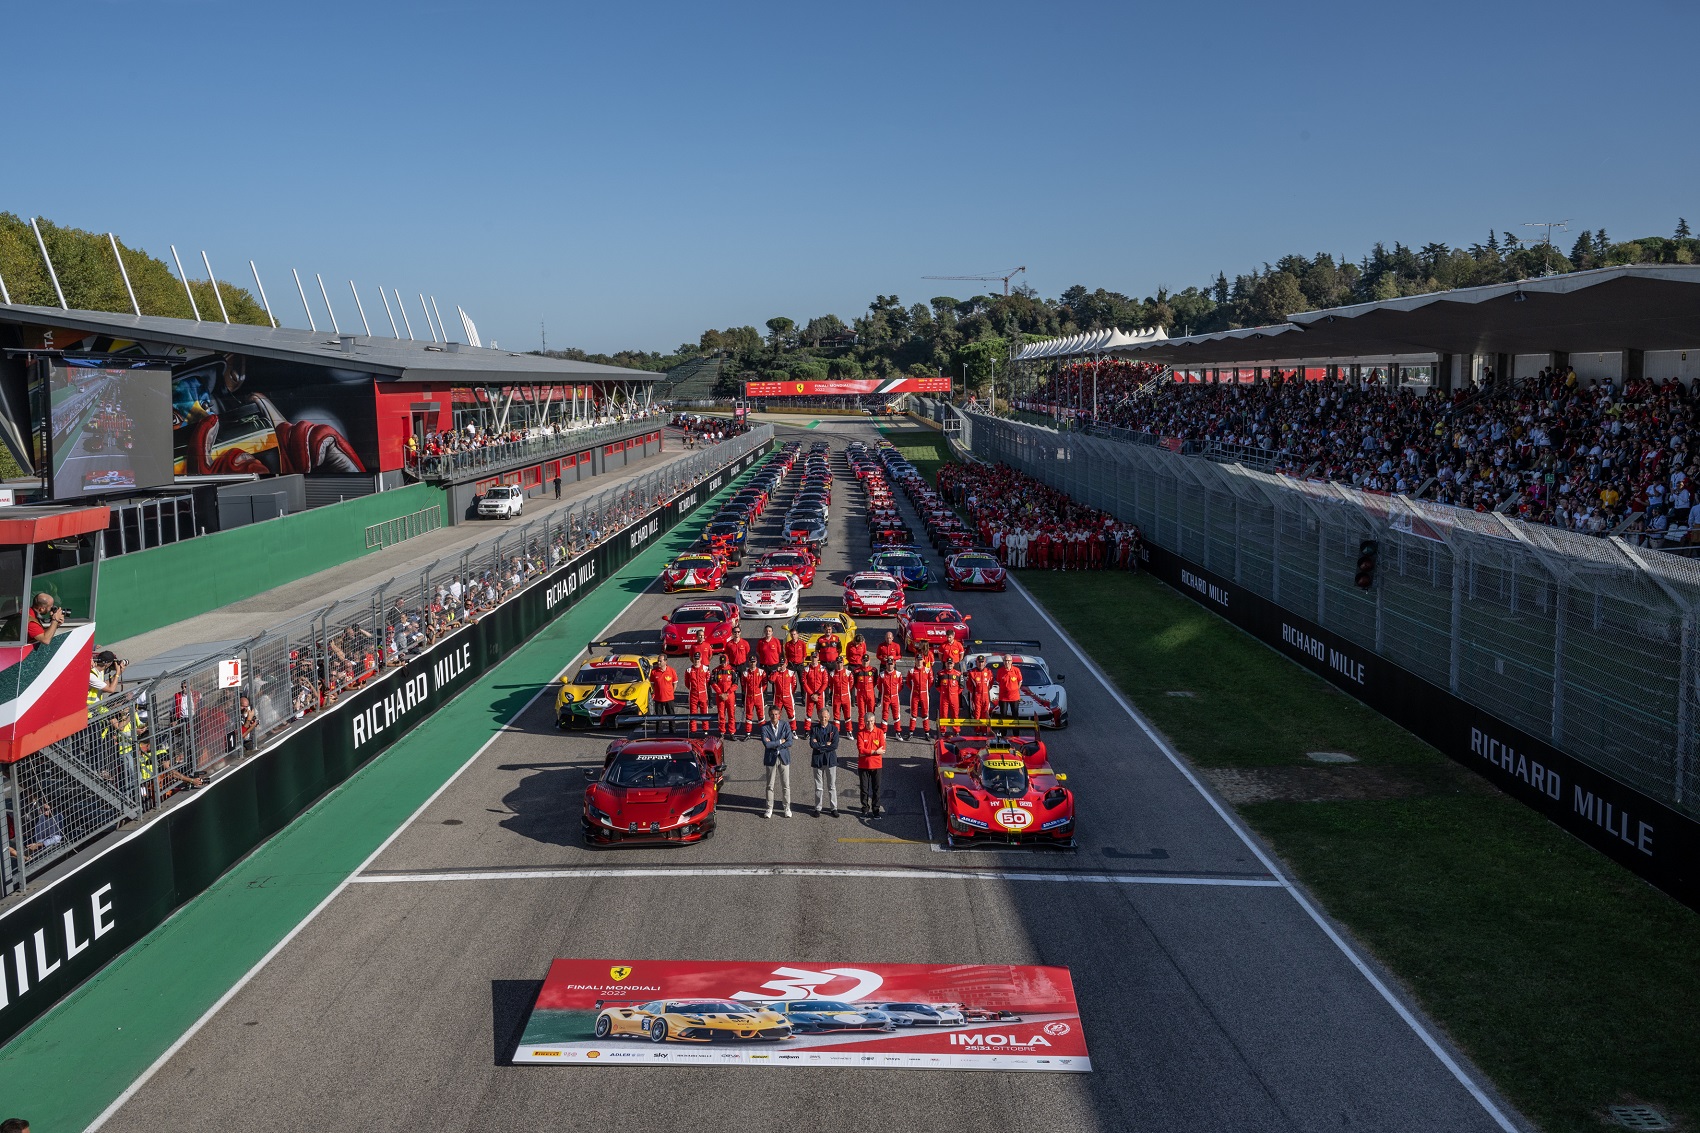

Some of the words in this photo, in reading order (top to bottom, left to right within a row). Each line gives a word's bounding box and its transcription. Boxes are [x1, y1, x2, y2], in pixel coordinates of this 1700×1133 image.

[630, 524, 648, 549] RICHARD
[648, 517, 658, 536] MILLE
[546, 572, 577, 610] RICHARD
[578, 559, 596, 587] MILLE
[1181, 569, 1206, 595] RICHARD
[1208, 584, 1229, 607] MILLE
[1282, 622, 1325, 662] RICHARD
[1329, 648, 1365, 685] MILLE
[353, 672, 428, 750] RICHARD
[434, 642, 471, 692] MILLE
[229, 735, 234, 748] 1
[1471, 726, 1561, 801] RICHARD
[1574, 784, 1654, 857] MILLE
[1003, 814, 1025, 823] 50
[729, 967, 883, 1001] 30
[949, 1034, 1052, 1047] IMOLA
